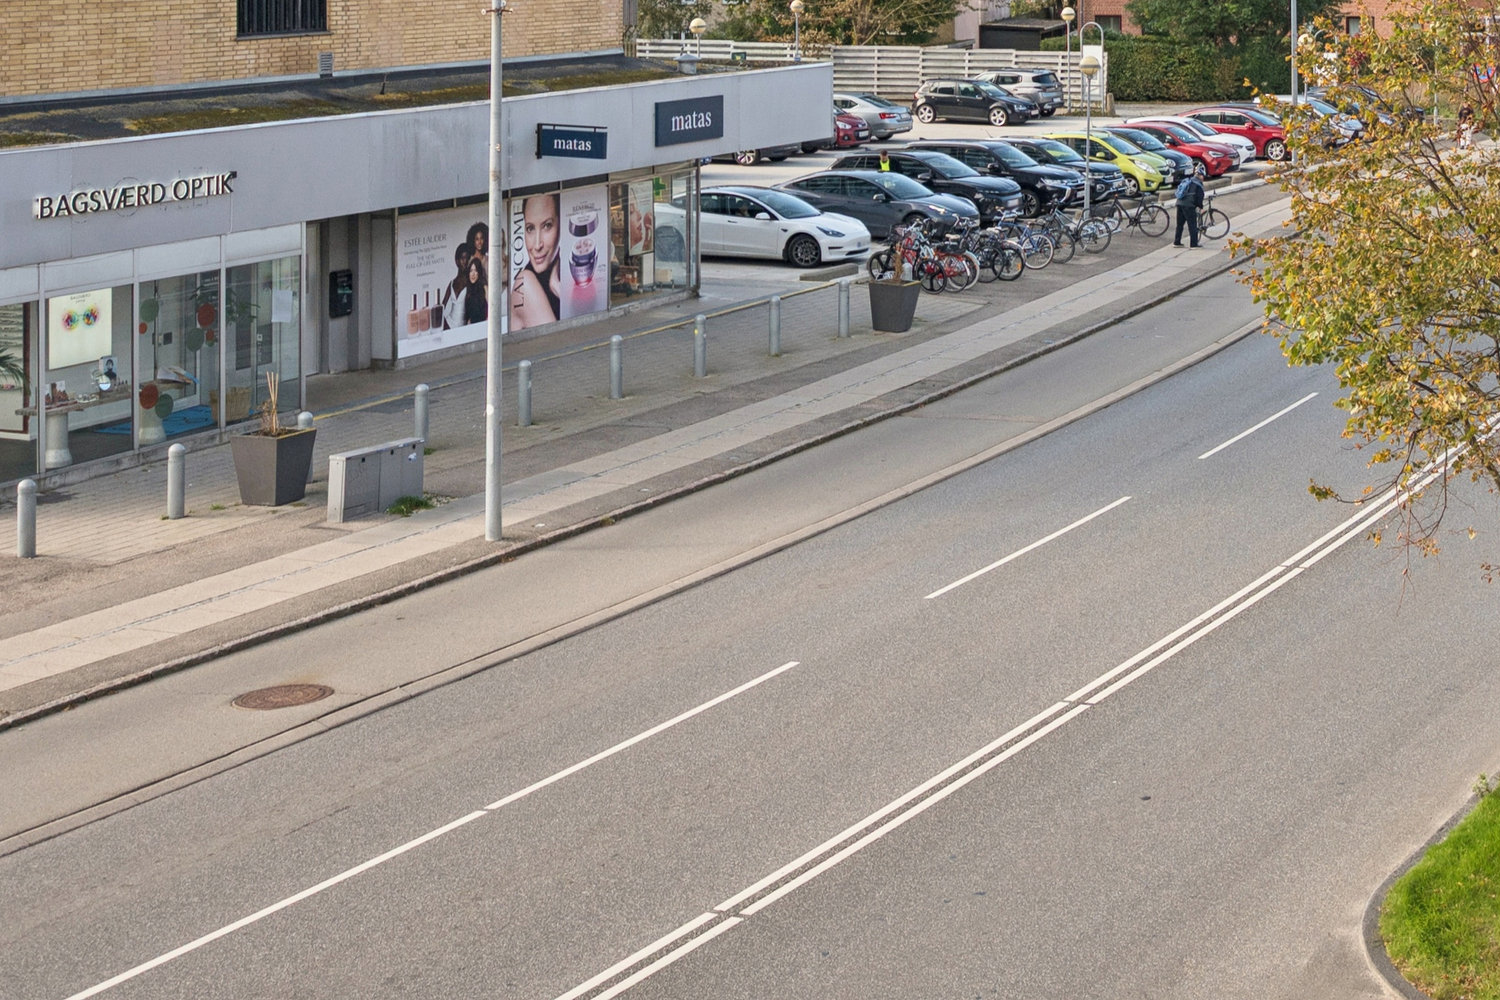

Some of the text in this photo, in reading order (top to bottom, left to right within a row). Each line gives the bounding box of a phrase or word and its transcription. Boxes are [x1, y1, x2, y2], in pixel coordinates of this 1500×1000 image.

[671, 112, 712, 132] matas
[554, 138, 592, 151] matas
[37, 172, 236, 219] BAGSVÆRD OPTIK
